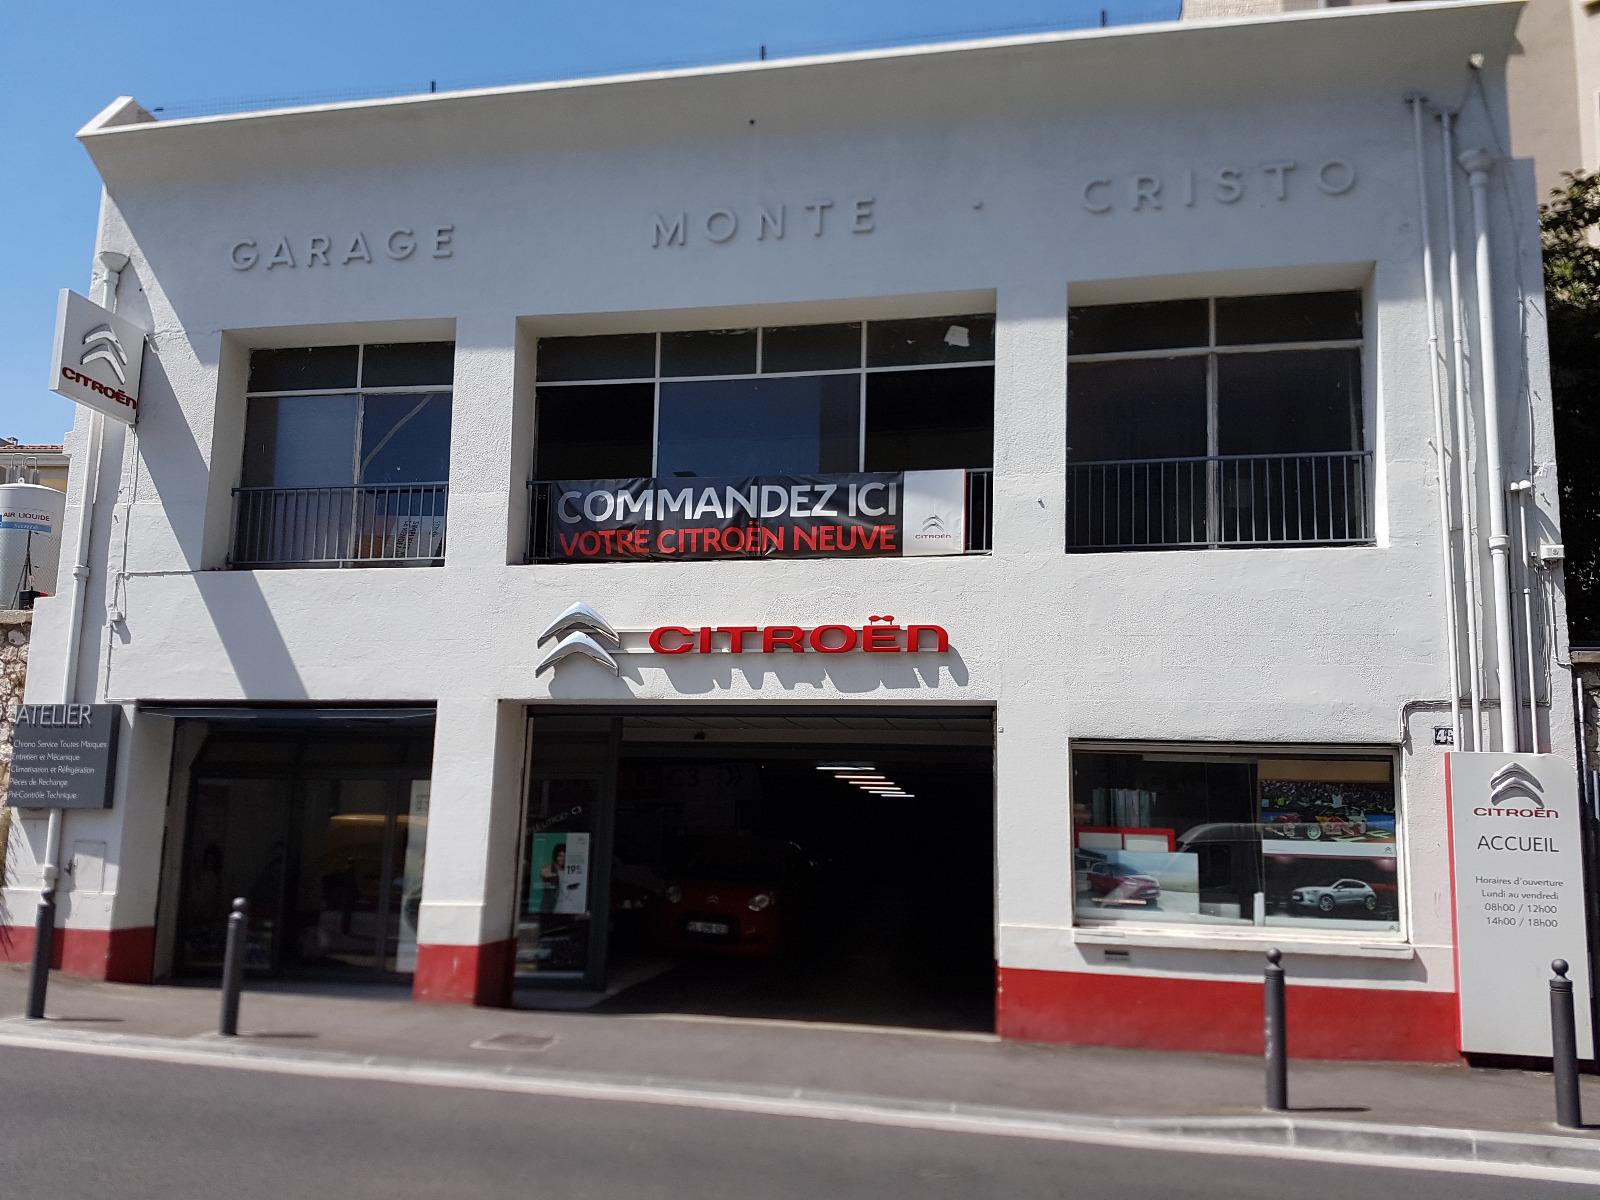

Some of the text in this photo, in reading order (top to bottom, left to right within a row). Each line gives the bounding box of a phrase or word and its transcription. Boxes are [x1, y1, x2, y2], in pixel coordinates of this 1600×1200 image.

[229, 158, 1357, 272] GARAGE MONTE CRISTO
[62, 366, 137, 409] CITROËN
[557, 482, 897, 524] COMMANDEZ ICI
[18, 512, 51, 522] LIQUIDE
[559, 521, 897, 556] VOTRE CITROËN NEUVE
[648, 615, 950, 655] CITROËN
[15, 704, 91, 725] ATELIER
[14, 739, 108, 750] Chrono Service Toutes Marques
[11, 752, 38, 761] Entretien
[47, 752, 80, 762] Mécanique
[10, 765, 48, 773] Climatisation
[29, 777, 37, 786] de
[39, 777, 68, 788] Rechange
[46, 790, 78, 800] Technique
[1473, 807, 1559, 819] CITROËN
[1476, 834, 1560, 853] ACCUEIL
[1475, 875, 1564, 887] Horaires d'ouverture
[1481, 889, 1506, 898] Lundi
[1521, 891, 1559, 900] vendredi
[1484, 902, 1516, 912] 08h00
[1527, 904, 1558, 914] 12h00
[1487, 916, 1517, 926] 14h00
[1528, 918, 1559, 928] 18h00
